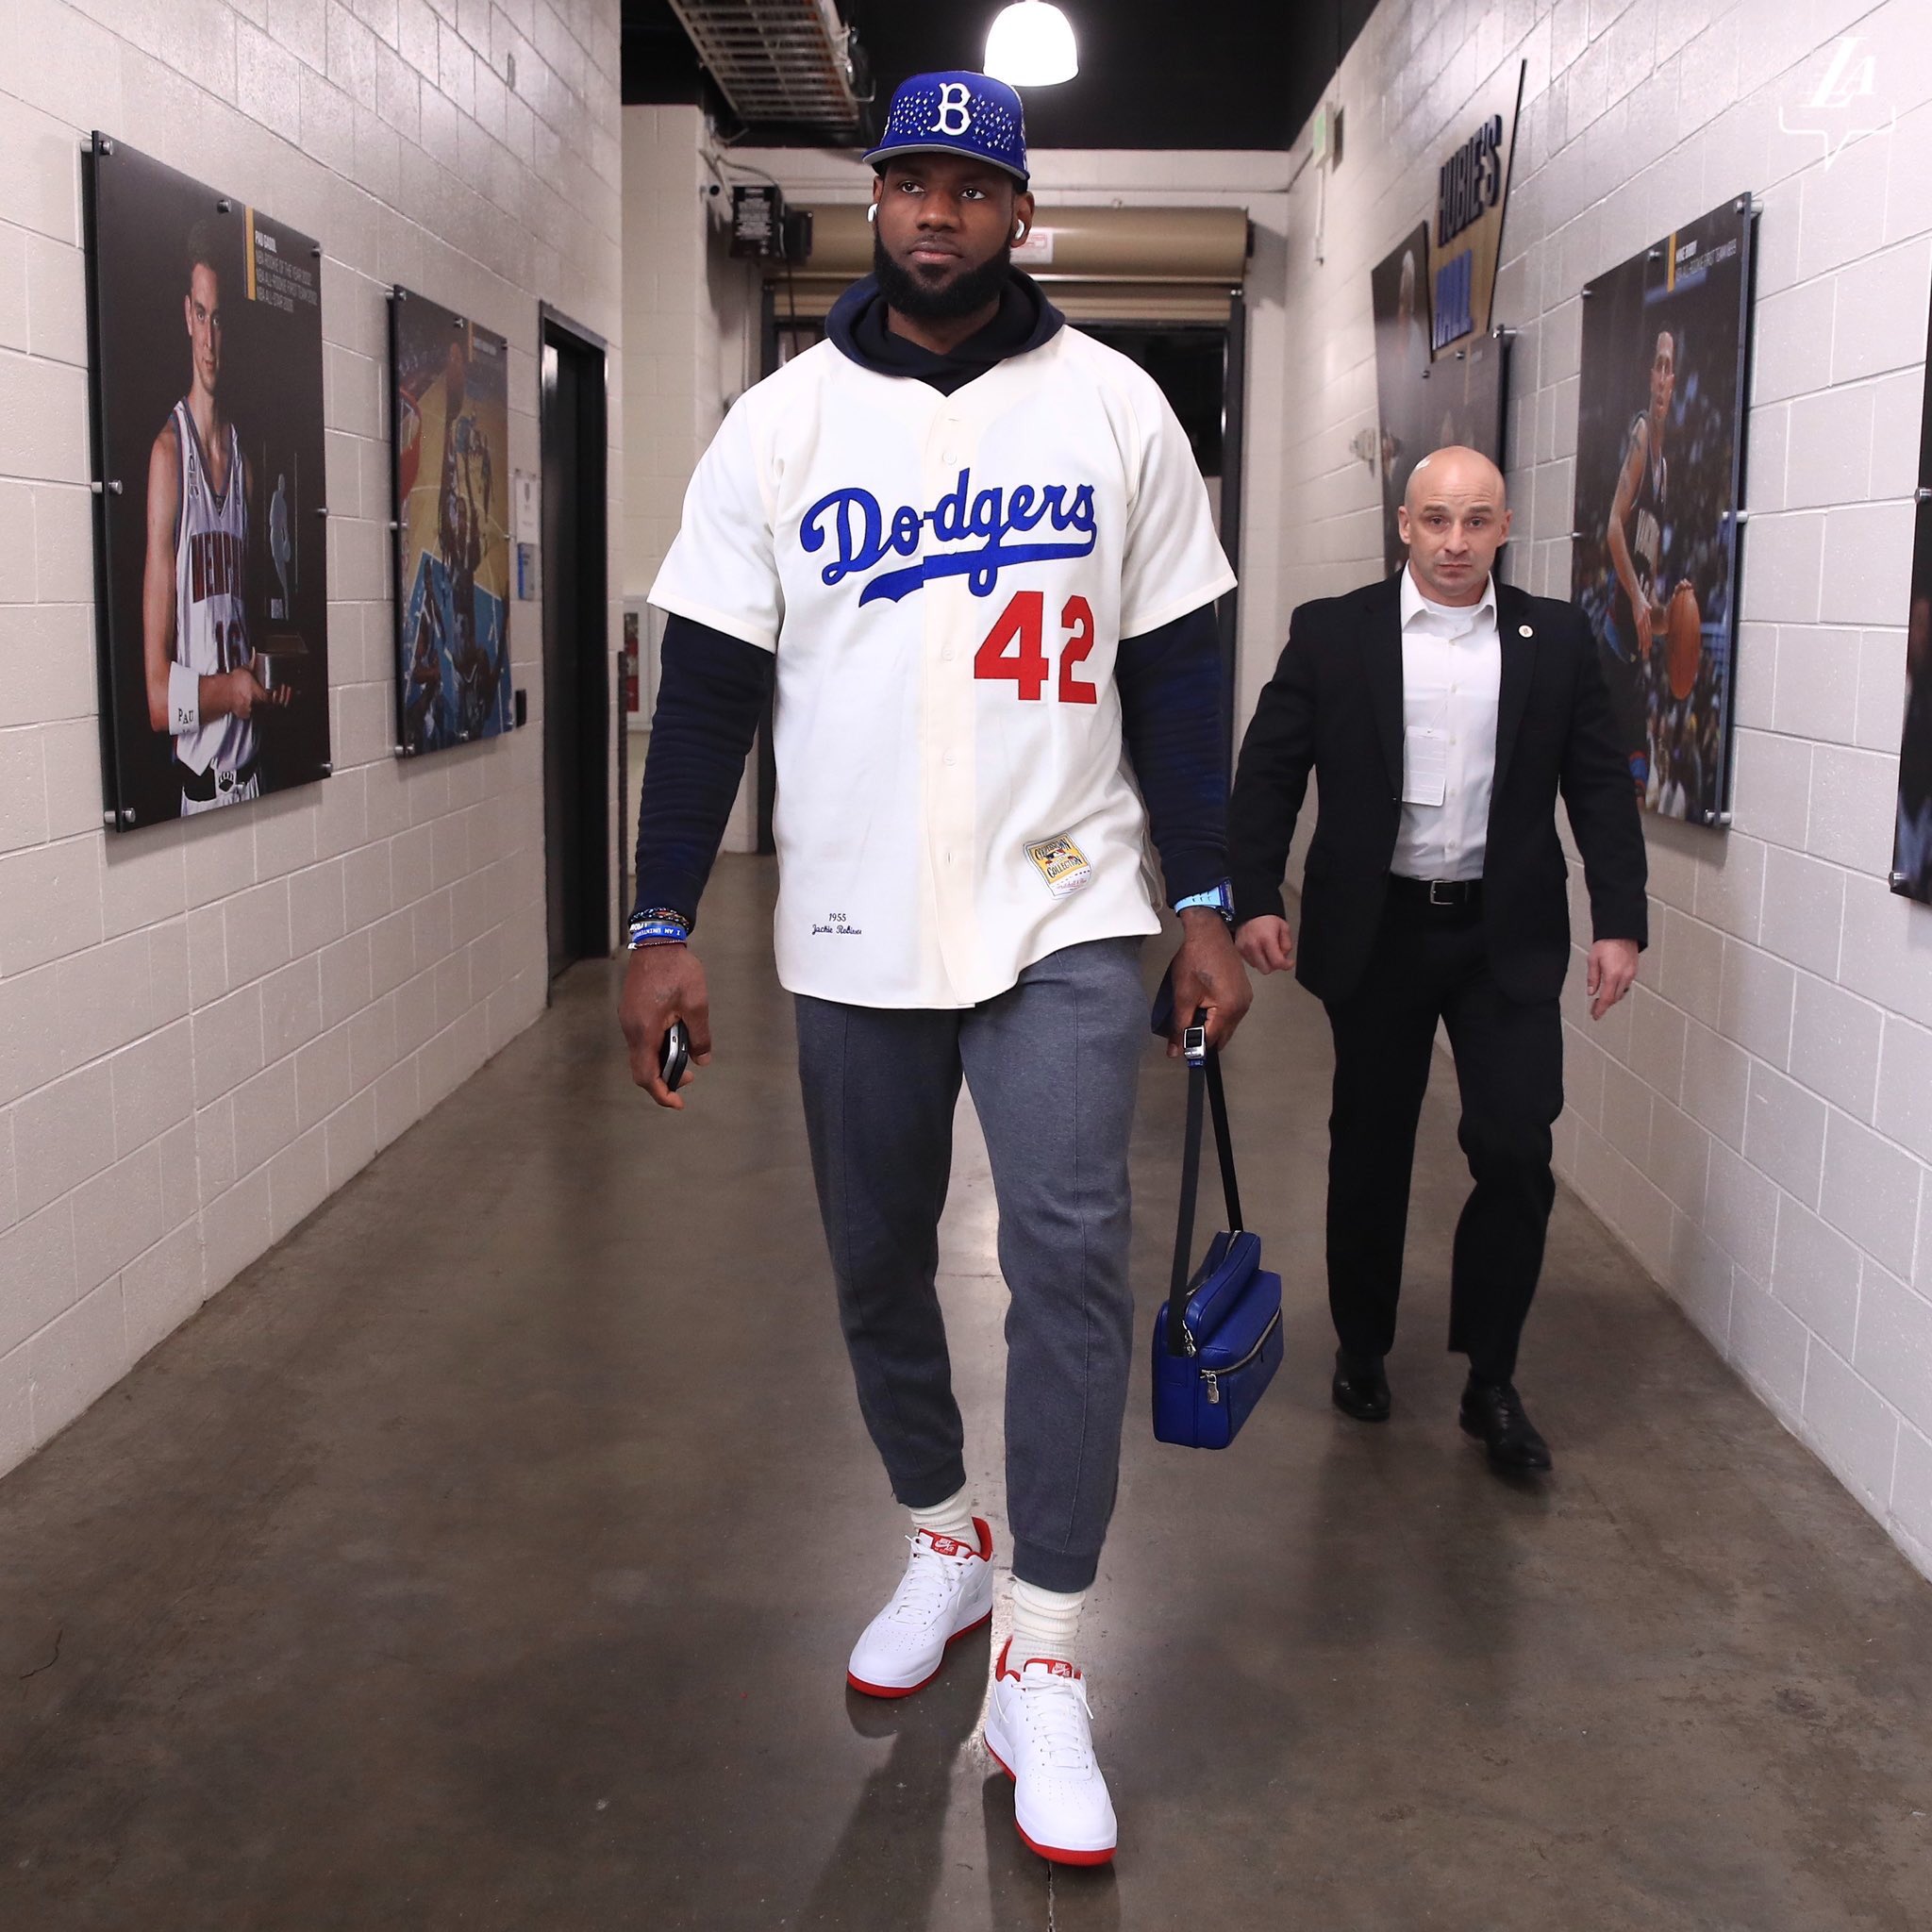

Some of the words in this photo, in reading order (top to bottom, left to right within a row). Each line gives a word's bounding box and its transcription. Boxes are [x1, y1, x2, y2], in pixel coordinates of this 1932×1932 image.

[930, 82, 972, 136] B
[1438, 114, 1502, 247] HUBIE'S
[800, 467, 1097, 608] Dodgers
[974, 591, 1097, 705] 42
[178, 708, 193, 724] PAU
[812, 924, 833, 935] Jackie
[828, 912, 846, 923] 1955
